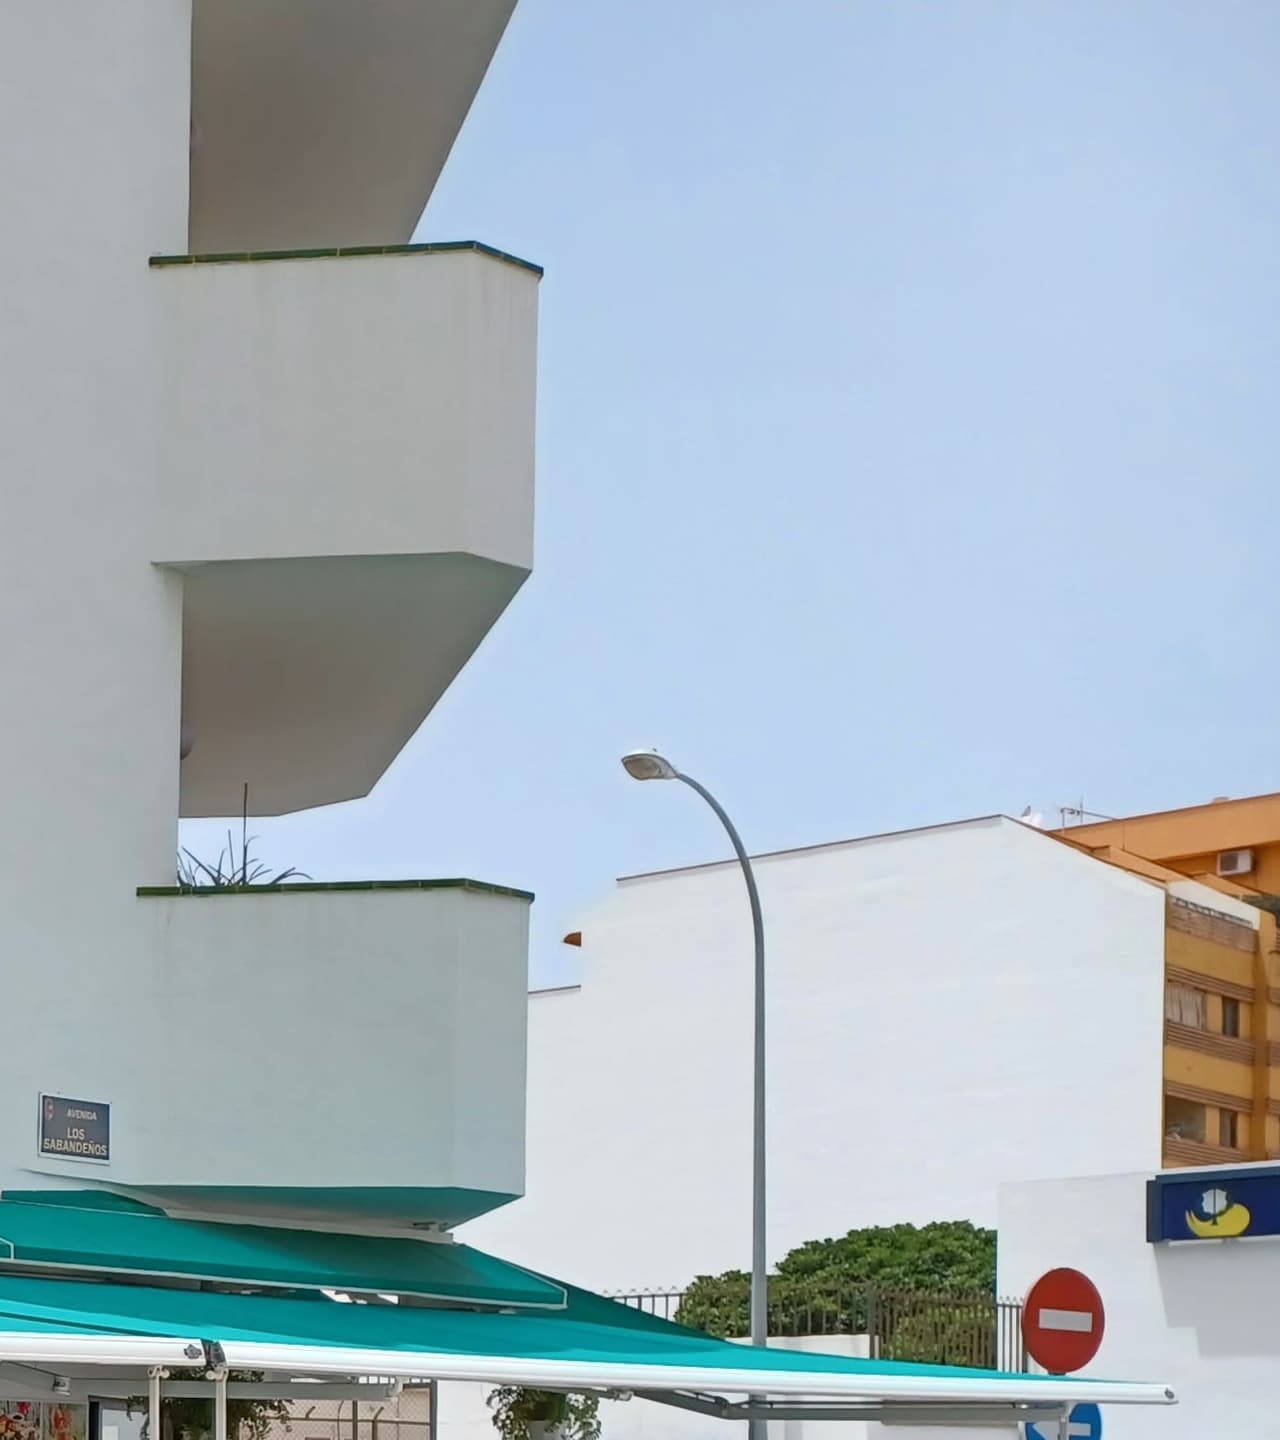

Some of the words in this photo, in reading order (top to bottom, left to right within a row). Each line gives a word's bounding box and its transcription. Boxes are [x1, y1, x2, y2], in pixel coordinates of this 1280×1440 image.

[66, 1108, 97, 1121] AVENIDA
[67, 1127, 85, 1140] LOS
[43, 1138, 108, 1156] SABANDEÑOS
